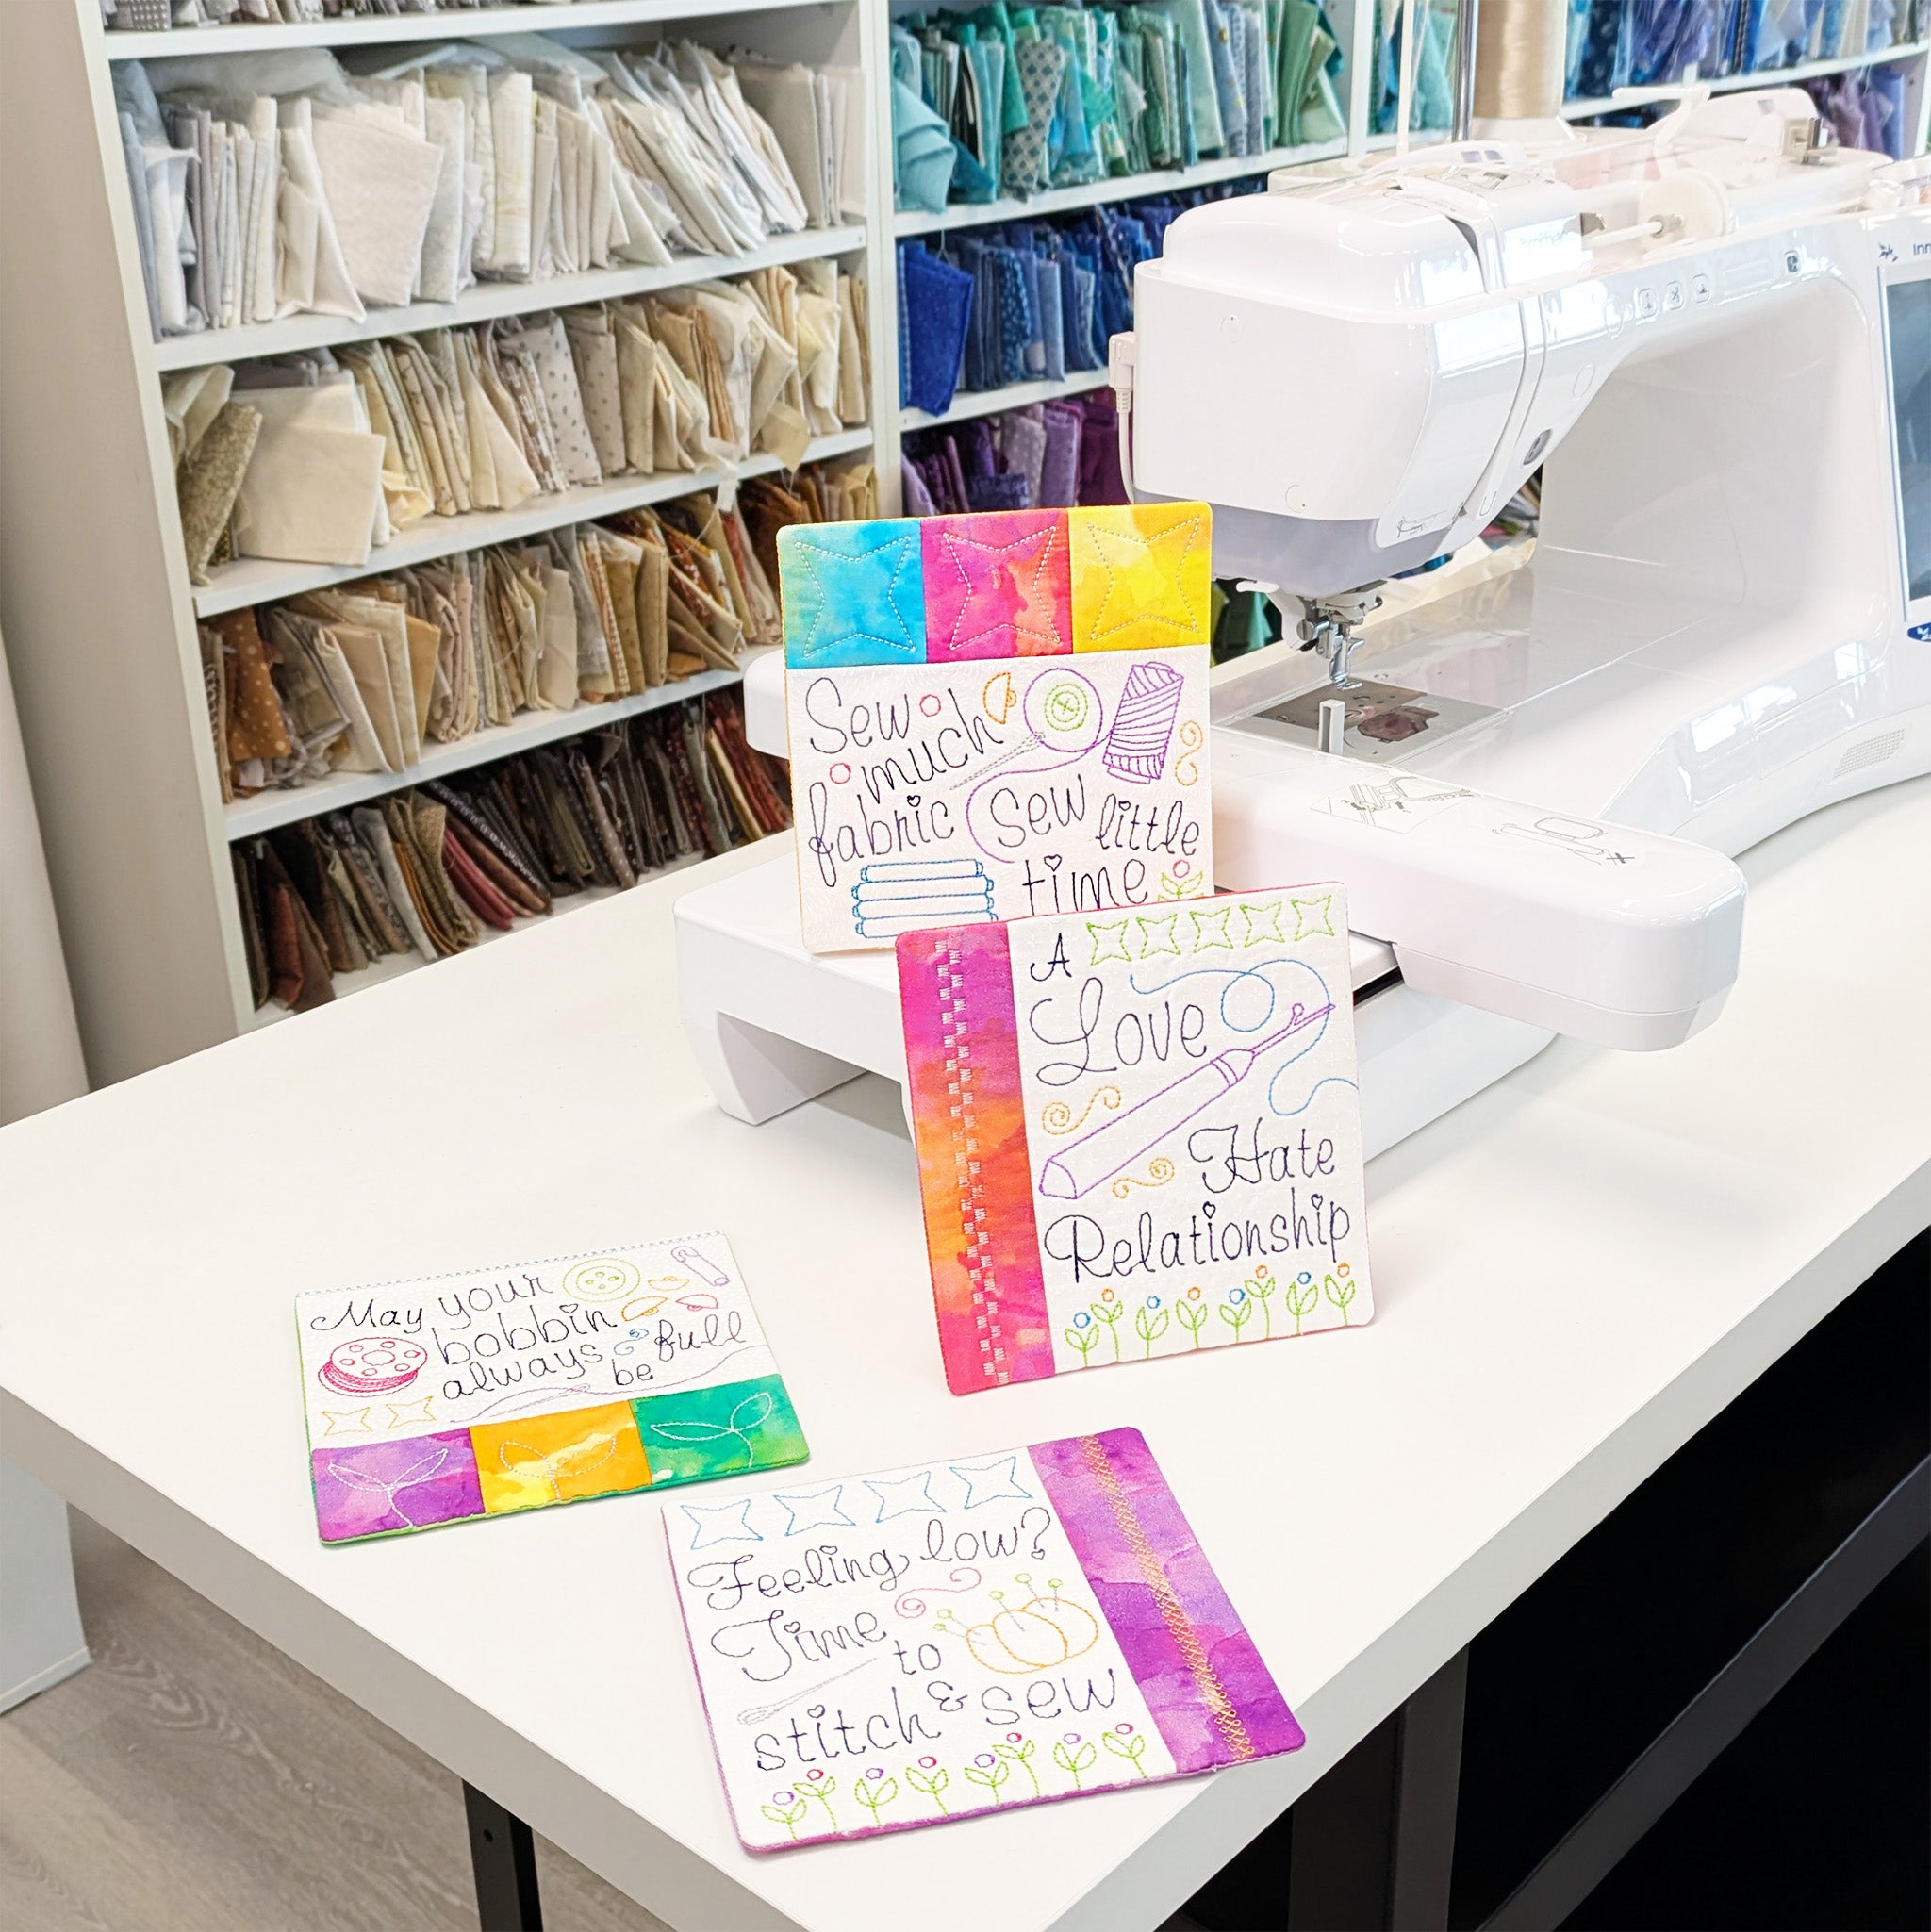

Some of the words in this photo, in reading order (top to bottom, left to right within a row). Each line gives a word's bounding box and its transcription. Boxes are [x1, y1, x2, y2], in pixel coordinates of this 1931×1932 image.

[805, 677, 910, 754] Sew
[861, 688, 1004, 804] much
[809, 782, 954, 887] fabric
[990, 774, 1085, 848] Sew
[1095, 793, 1200, 856] little
[1022, 854, 1148, 916] time
[1030, 933, 1072, 982] A
[1029, 977, 1207, 1086] Love
[1187, 1117, 1335, 1193] Hate
[1044, 1187, 1351, 1283] Relationship
[309, 1298, 423, 1333] May
[437, 1273, 553, 1330] your
[432, 1302, 619, 1366] bobbin
[443, 1343, 605, 1400] always
[612, 1358, 655, 1387] be
[653, 1310, 748, 1362] full
[687, 1544, 911, 1611] Feeling
[919, 1506, 1051, 1562] low?
[710, 1609, 887, 1682] Time
[893, 1639, 942, 1676] to
[753, 1685, 942, 1772] stitch
[926, 1680, 968, 1712] &
[981, 1667, 1117, 1726] sew
